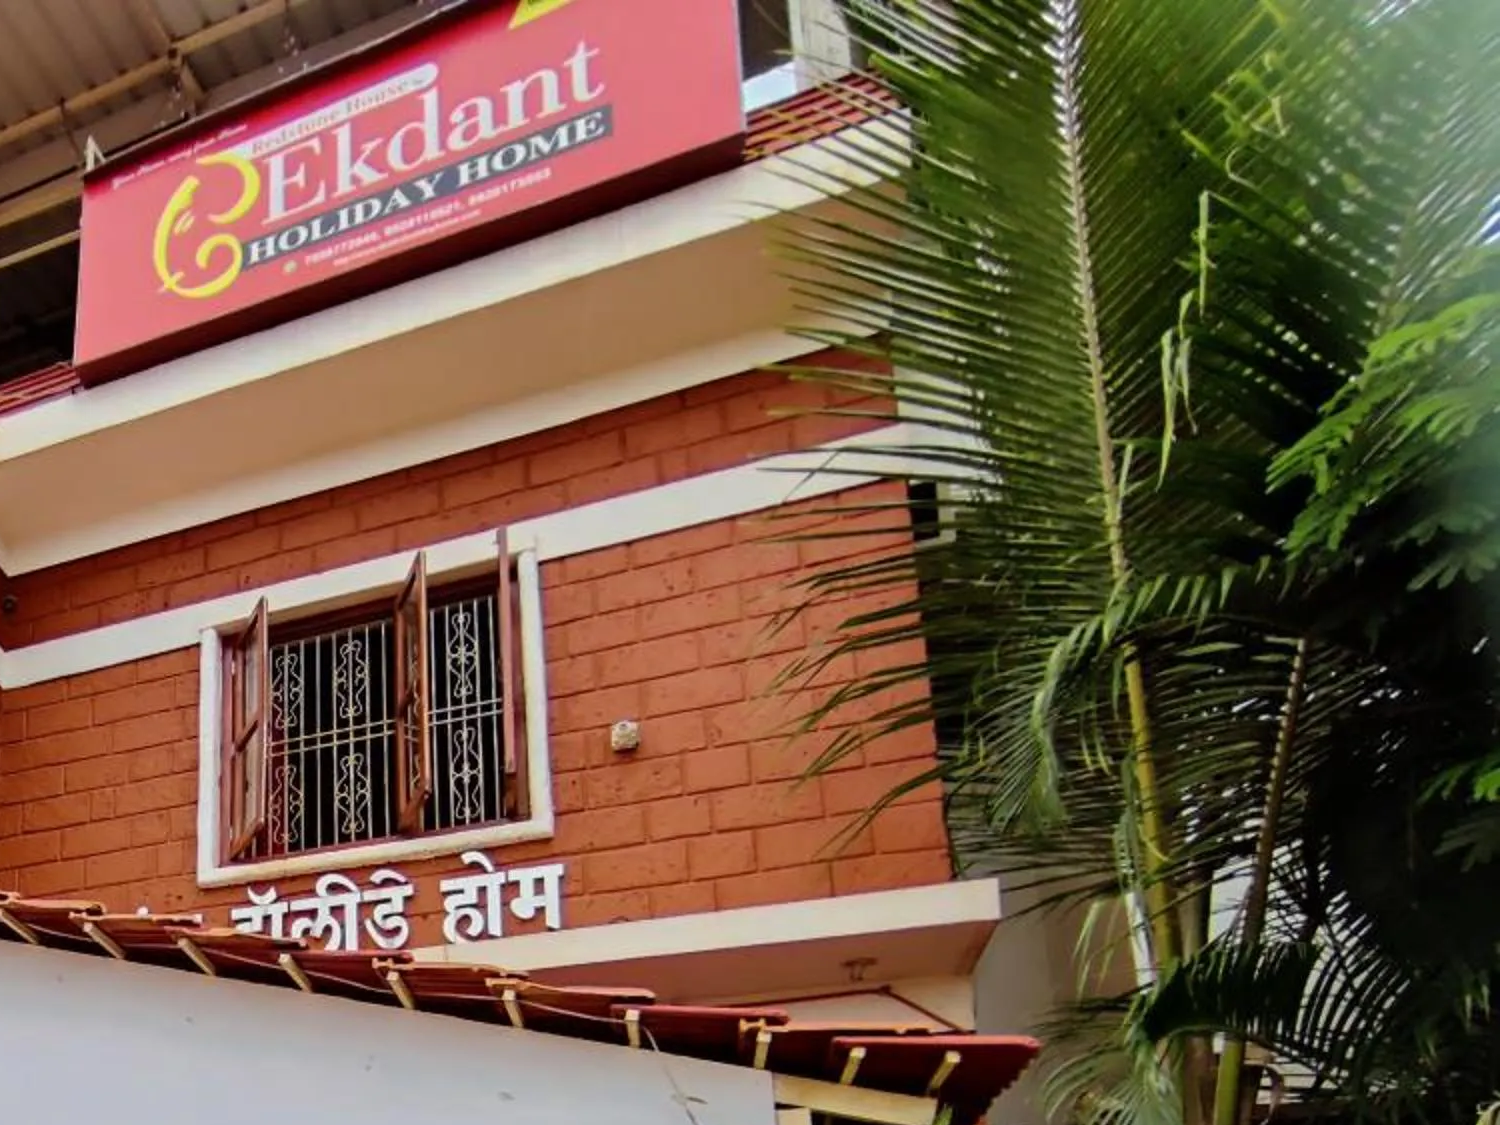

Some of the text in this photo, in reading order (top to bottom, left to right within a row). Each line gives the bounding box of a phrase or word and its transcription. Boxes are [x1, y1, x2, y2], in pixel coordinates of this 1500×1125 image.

[248, 171, 445, 265] HOLIDAY
[455, 111, 604, 188] HOME
[262, 40, 605, 225] Ekdant
[440, 850, 564, 944] होम
